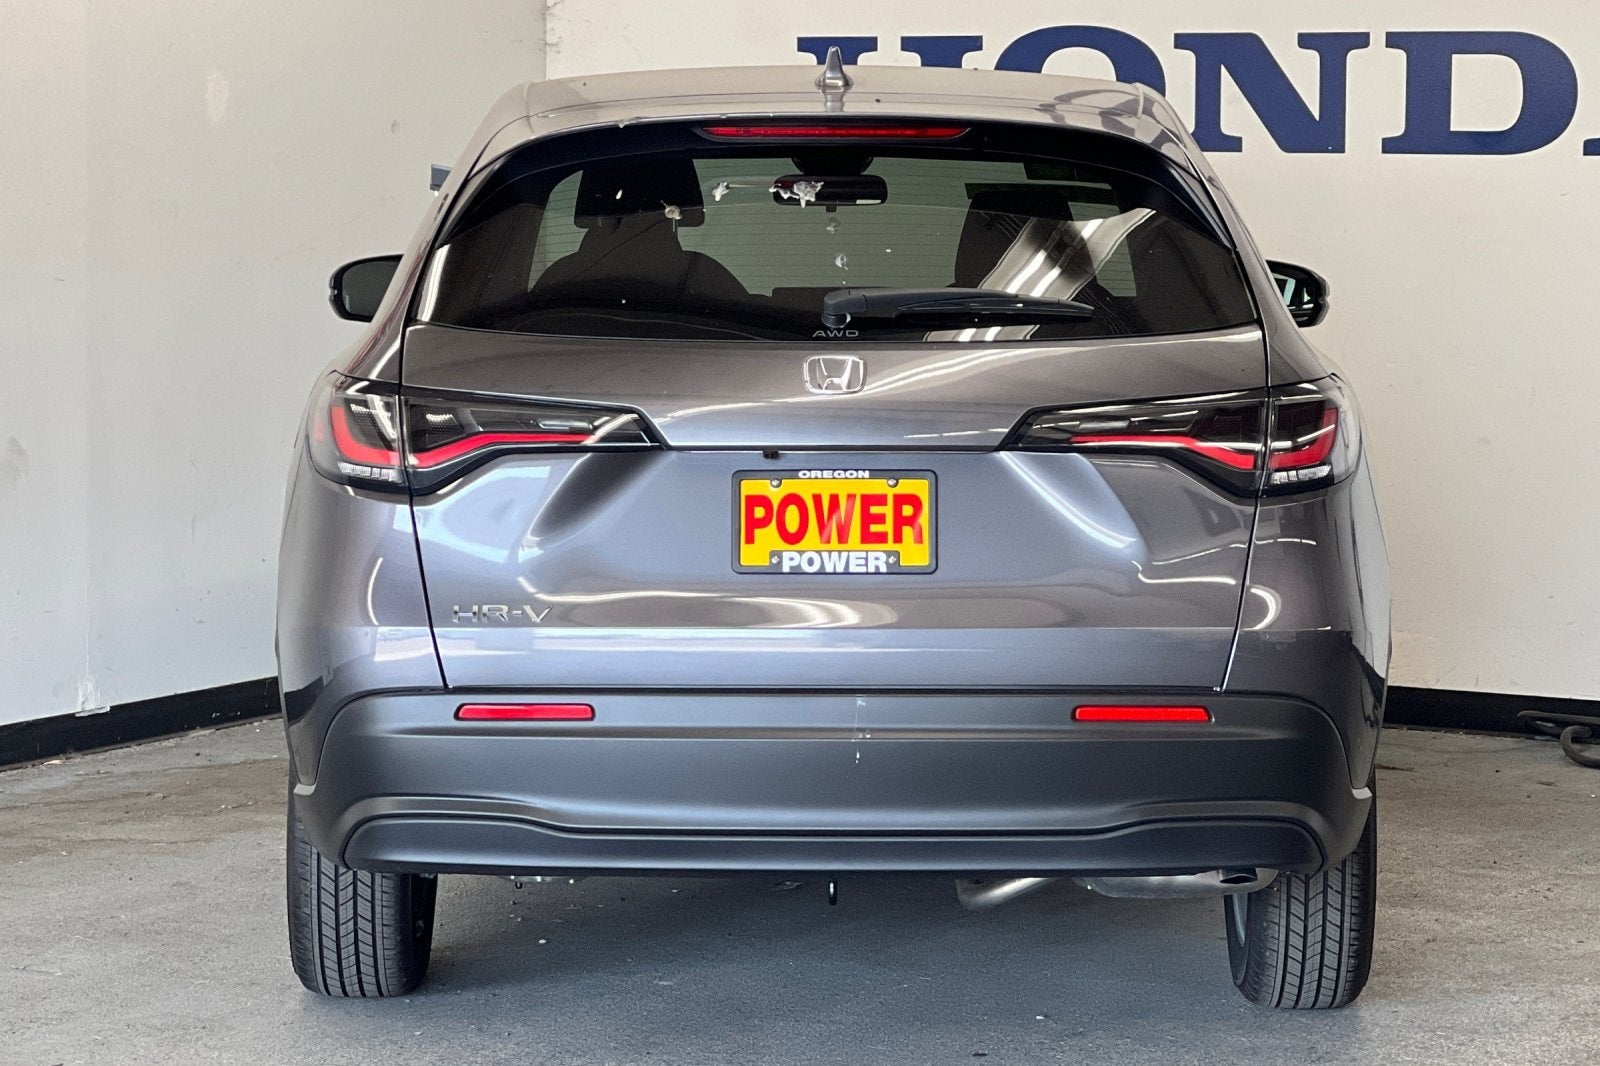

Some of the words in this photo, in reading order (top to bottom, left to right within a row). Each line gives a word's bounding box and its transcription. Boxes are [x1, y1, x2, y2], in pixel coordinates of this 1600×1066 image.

[812, 329, 859, 338] AWD
[797, 470, 870, 479] OREGON
[744, 492, 924, 545] POWER
[782, 551, 887, 573] POWER
[452, 604, 553, 623] HR-V
